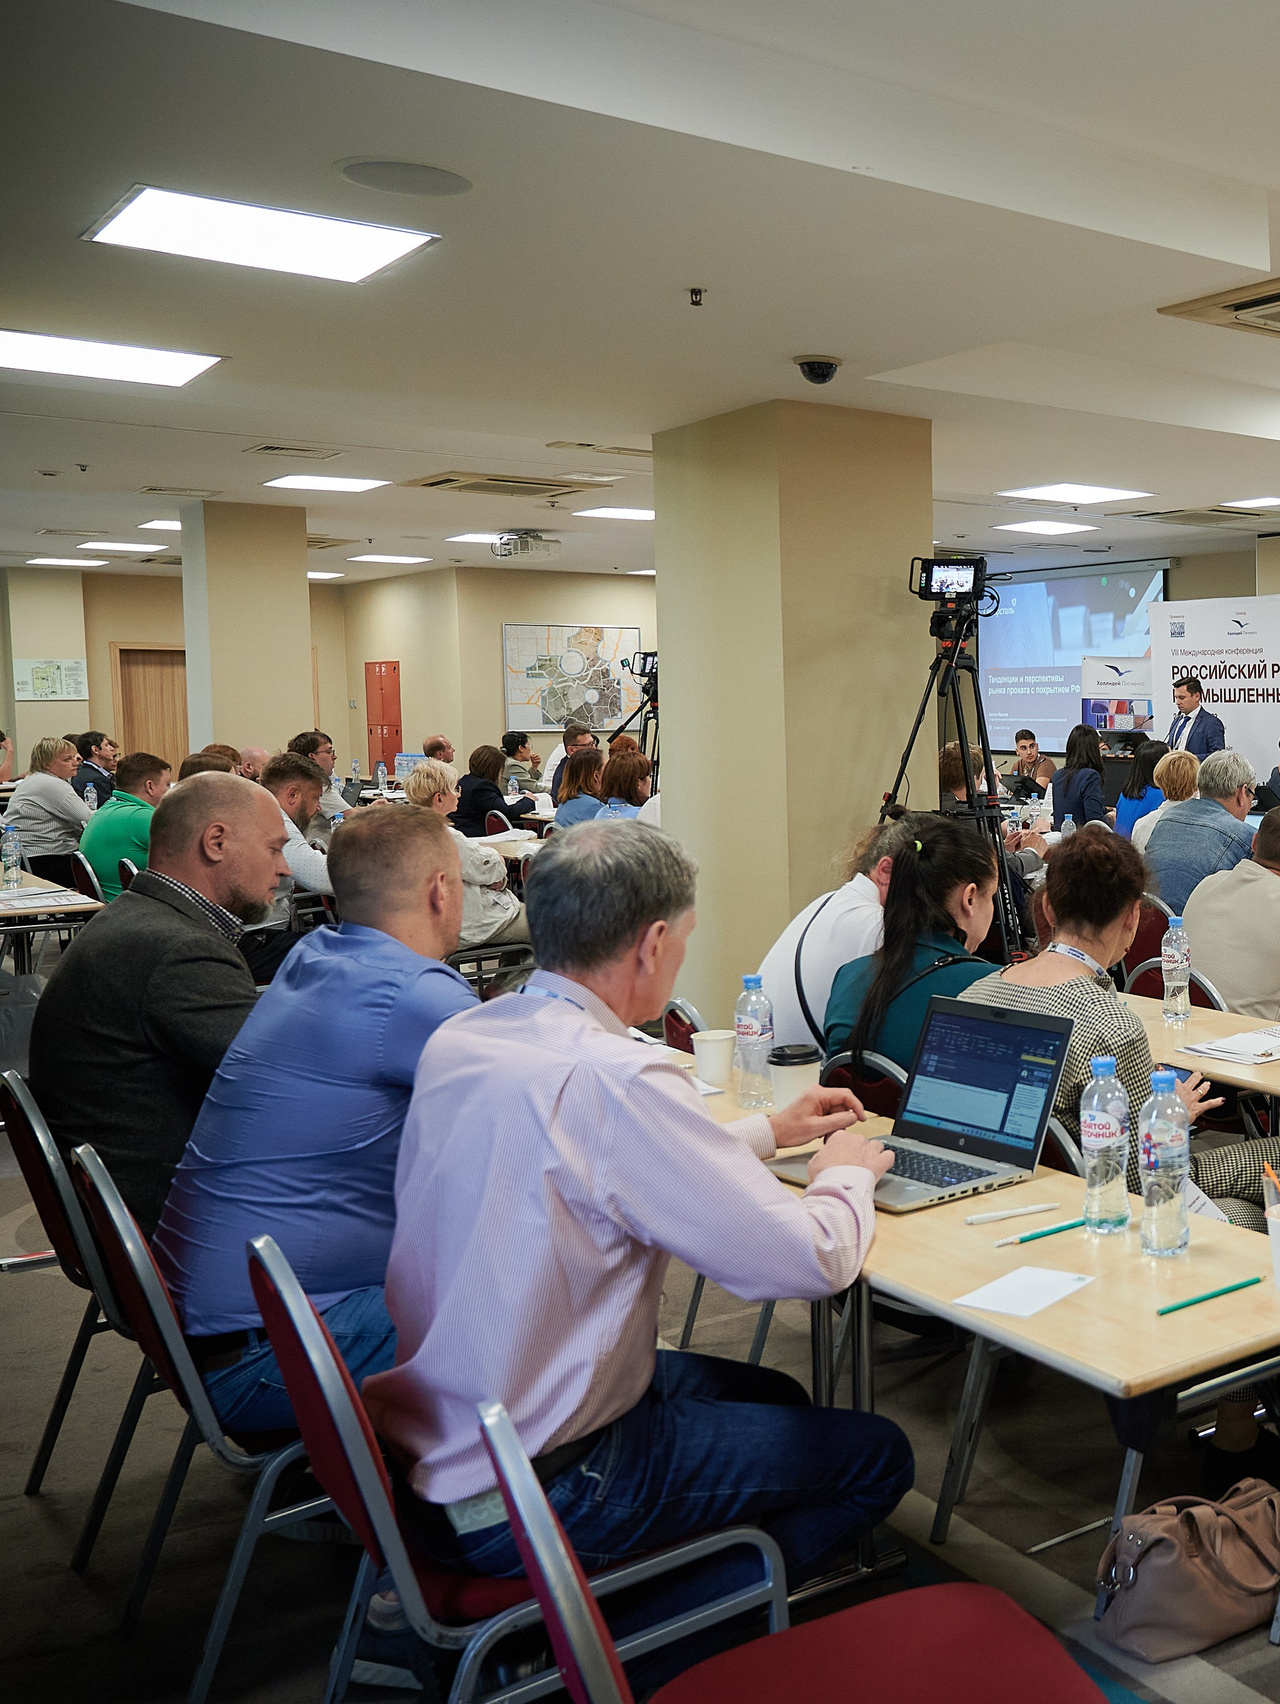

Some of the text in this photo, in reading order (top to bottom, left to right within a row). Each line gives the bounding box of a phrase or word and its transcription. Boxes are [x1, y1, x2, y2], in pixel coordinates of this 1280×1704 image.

[1179, 648, 1225, 657] Международная
[1225, 647, 1264, 656] конференция
[1171, 659, 1267, 680] РОССИЙСКИЙ
